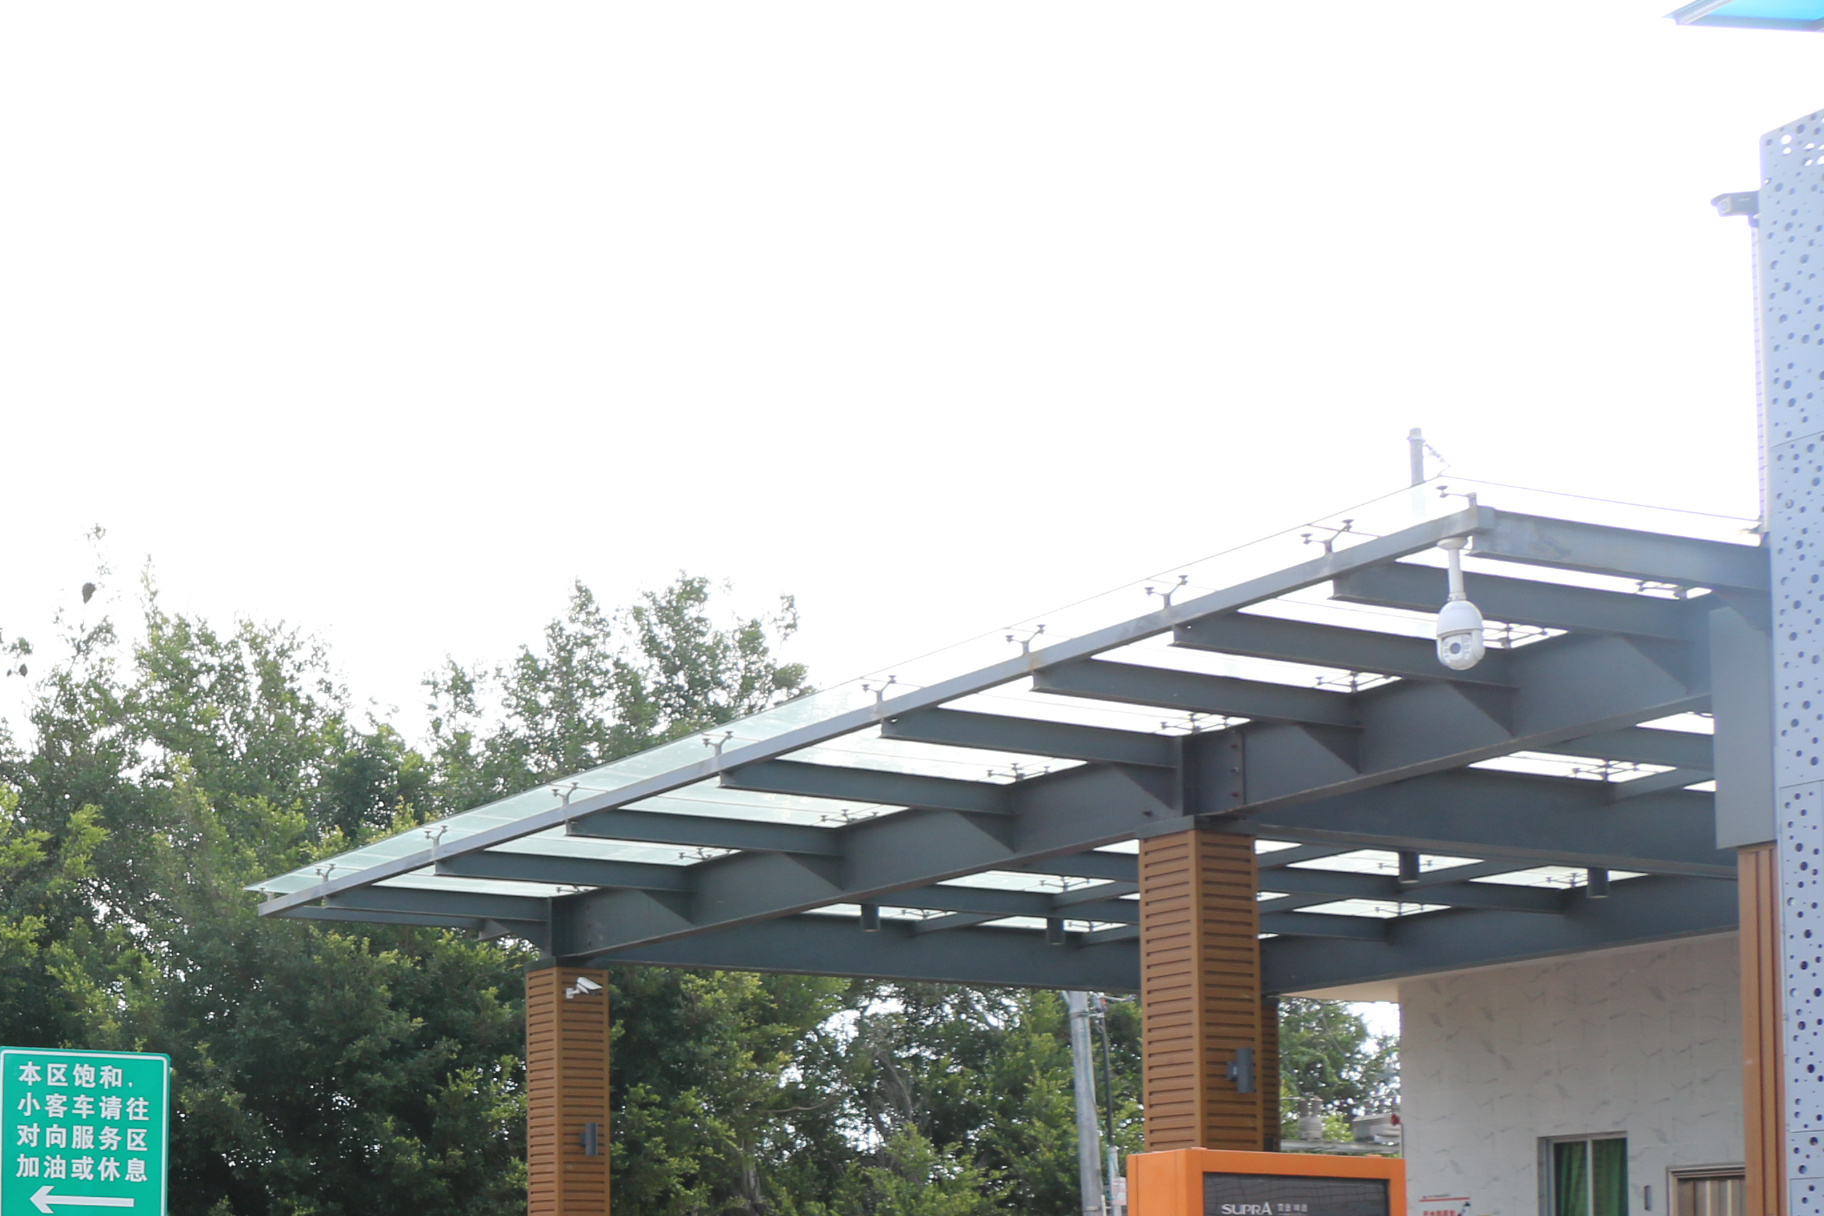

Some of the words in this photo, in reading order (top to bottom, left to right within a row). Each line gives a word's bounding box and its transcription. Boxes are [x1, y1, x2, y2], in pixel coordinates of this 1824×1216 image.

[17, 1092, 151, 1121] 小客车请往
[16, 1123, 149, 1152] 对向服务区
[15, 1154, 148, 1183] 加油或休息
